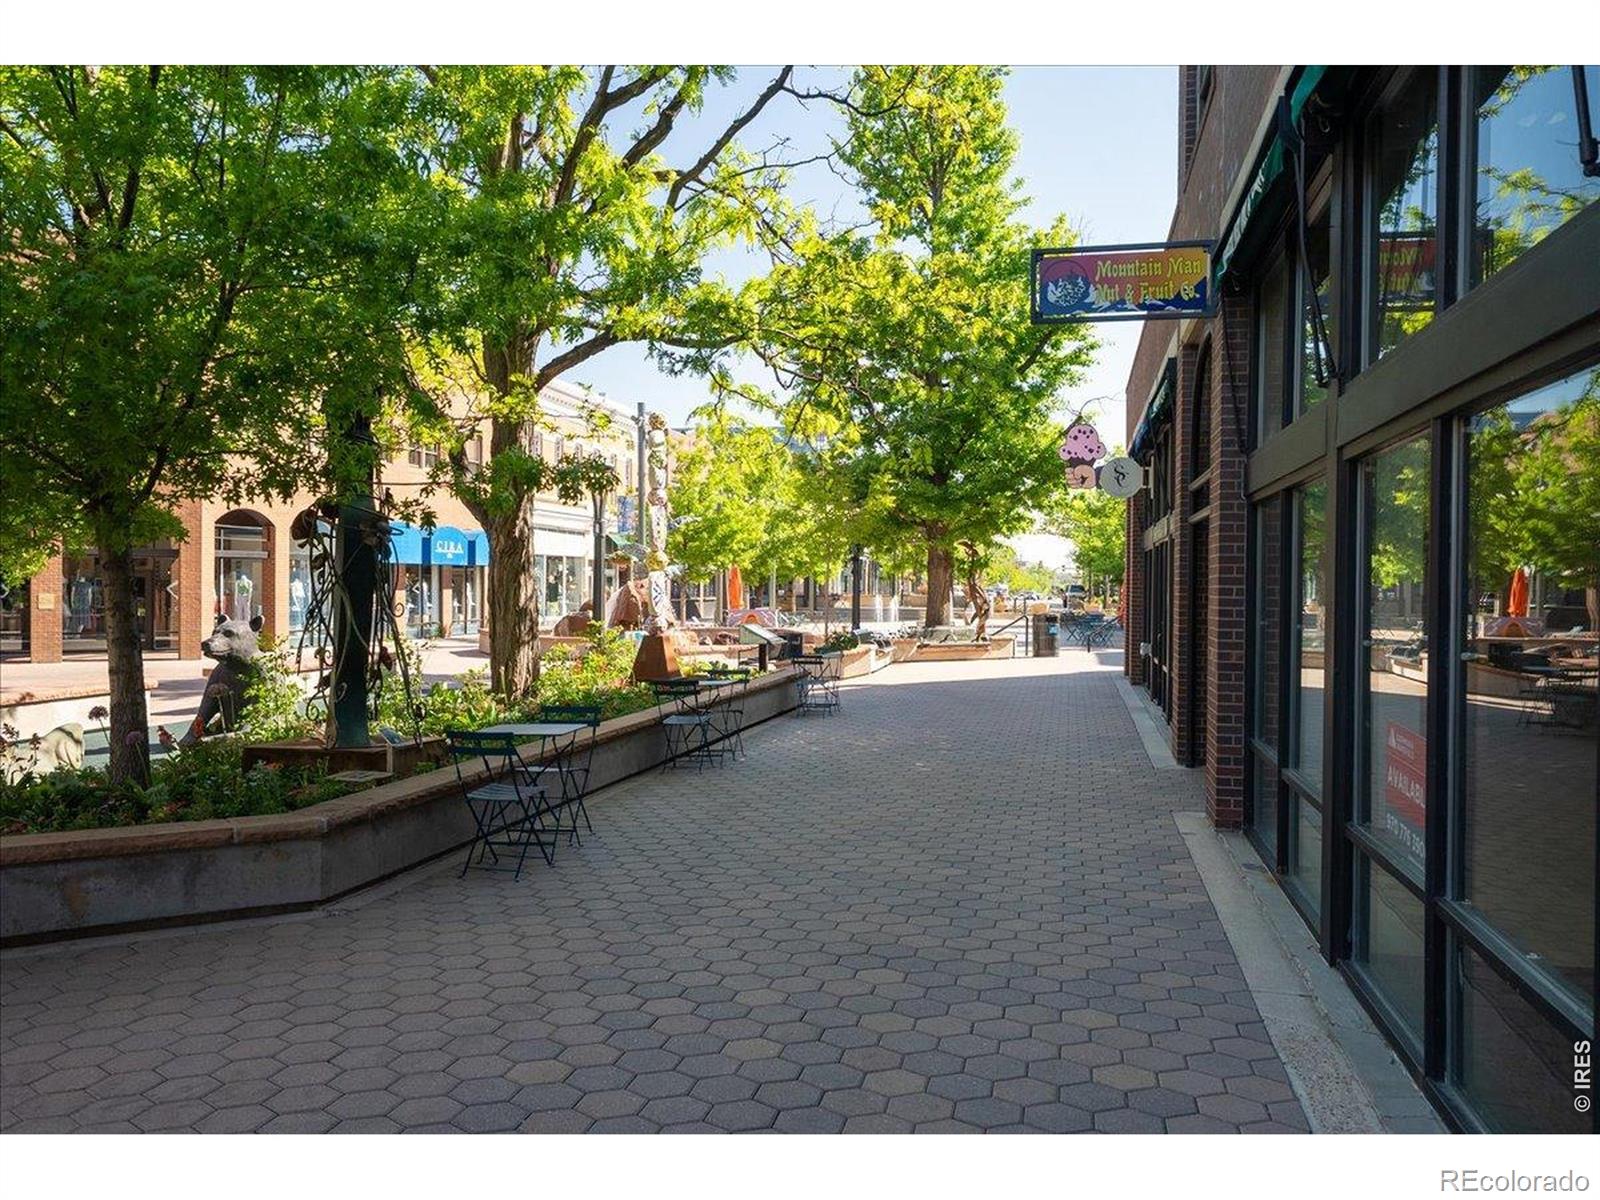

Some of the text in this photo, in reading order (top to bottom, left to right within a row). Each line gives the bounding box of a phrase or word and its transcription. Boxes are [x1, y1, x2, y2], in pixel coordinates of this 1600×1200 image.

[1095, 257, 1201, 281] Mountain Man
[1094, 284, 1120, 304] Nut
[1124, 284, 1136, 302] &
[1139, 281, 1175, 302] Fruit
[1387, 764, 1426, 809] AVAILABL
